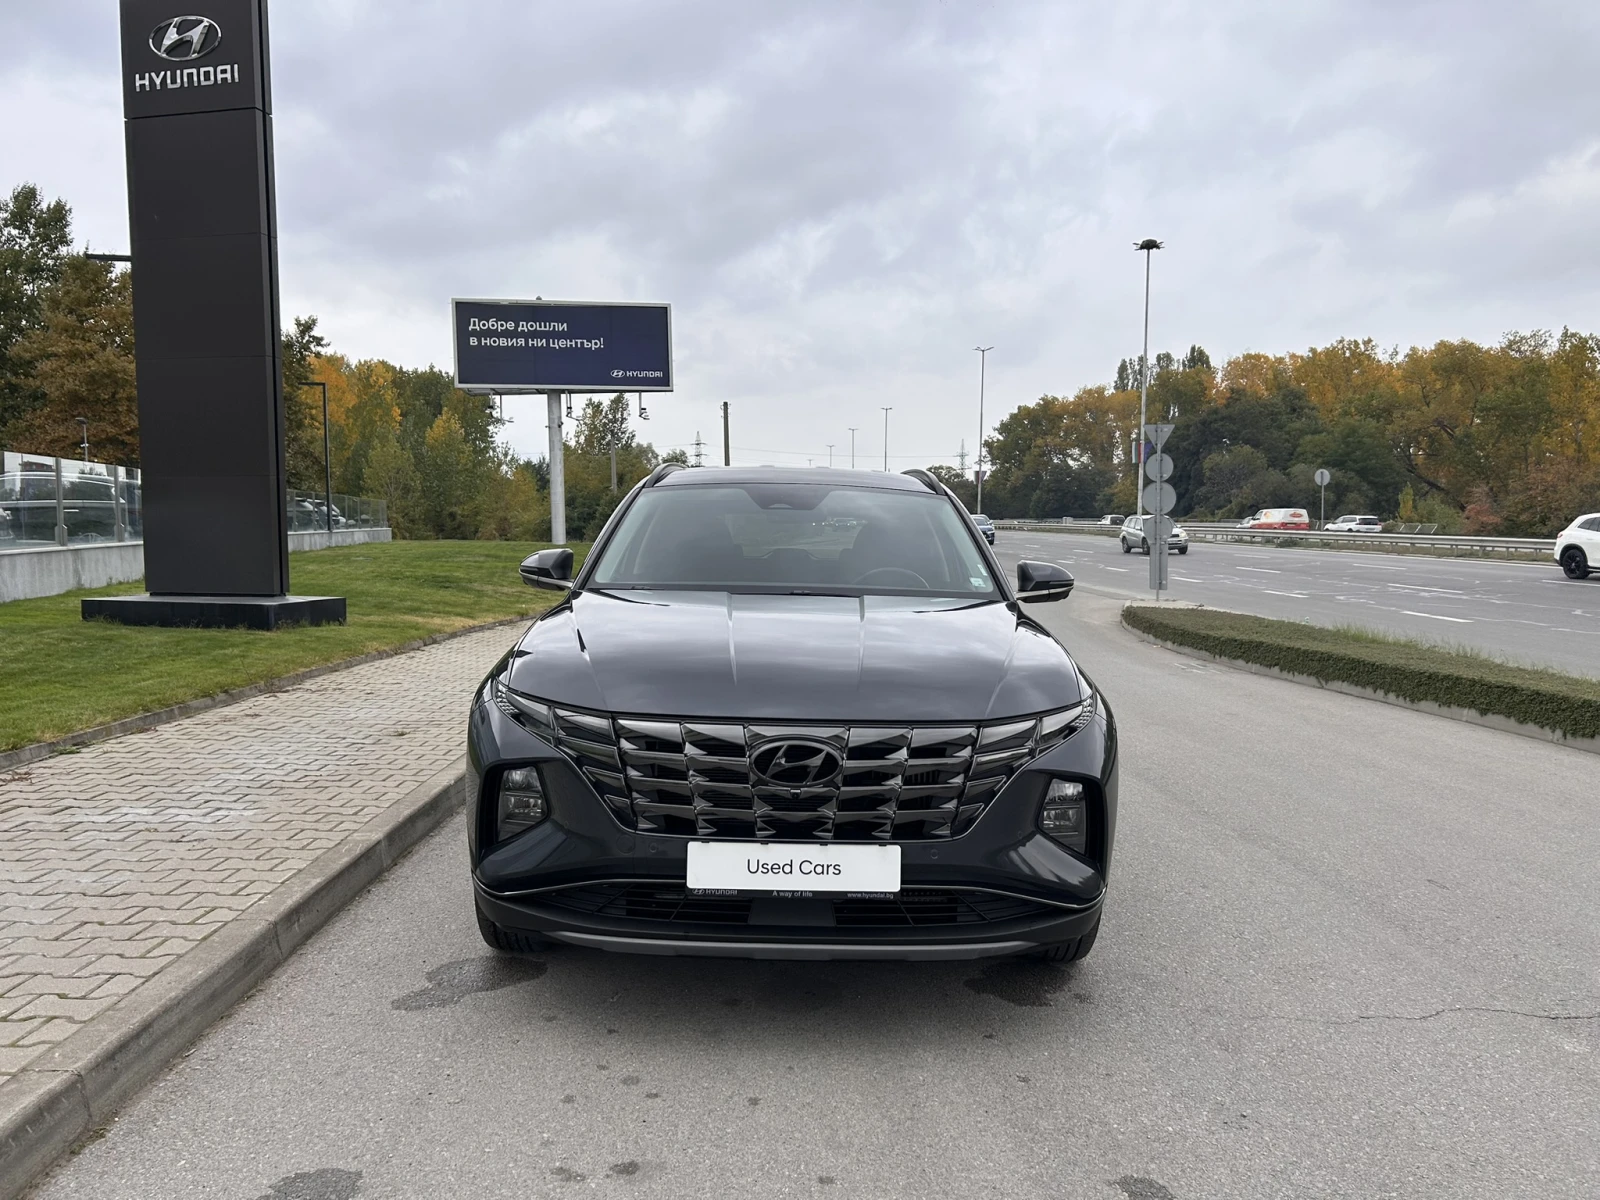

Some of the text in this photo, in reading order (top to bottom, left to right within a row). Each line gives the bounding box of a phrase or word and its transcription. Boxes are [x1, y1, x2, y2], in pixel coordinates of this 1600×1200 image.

[135, 63, 240, 92] HYUNDAI
[468, 318, 568, 332] Добре дошли
[469, 337, 605, 350] в новия ни център!
[626, 370, 663, 378] HYUNDAI
[746, 858, 842, 876] Used Cars
